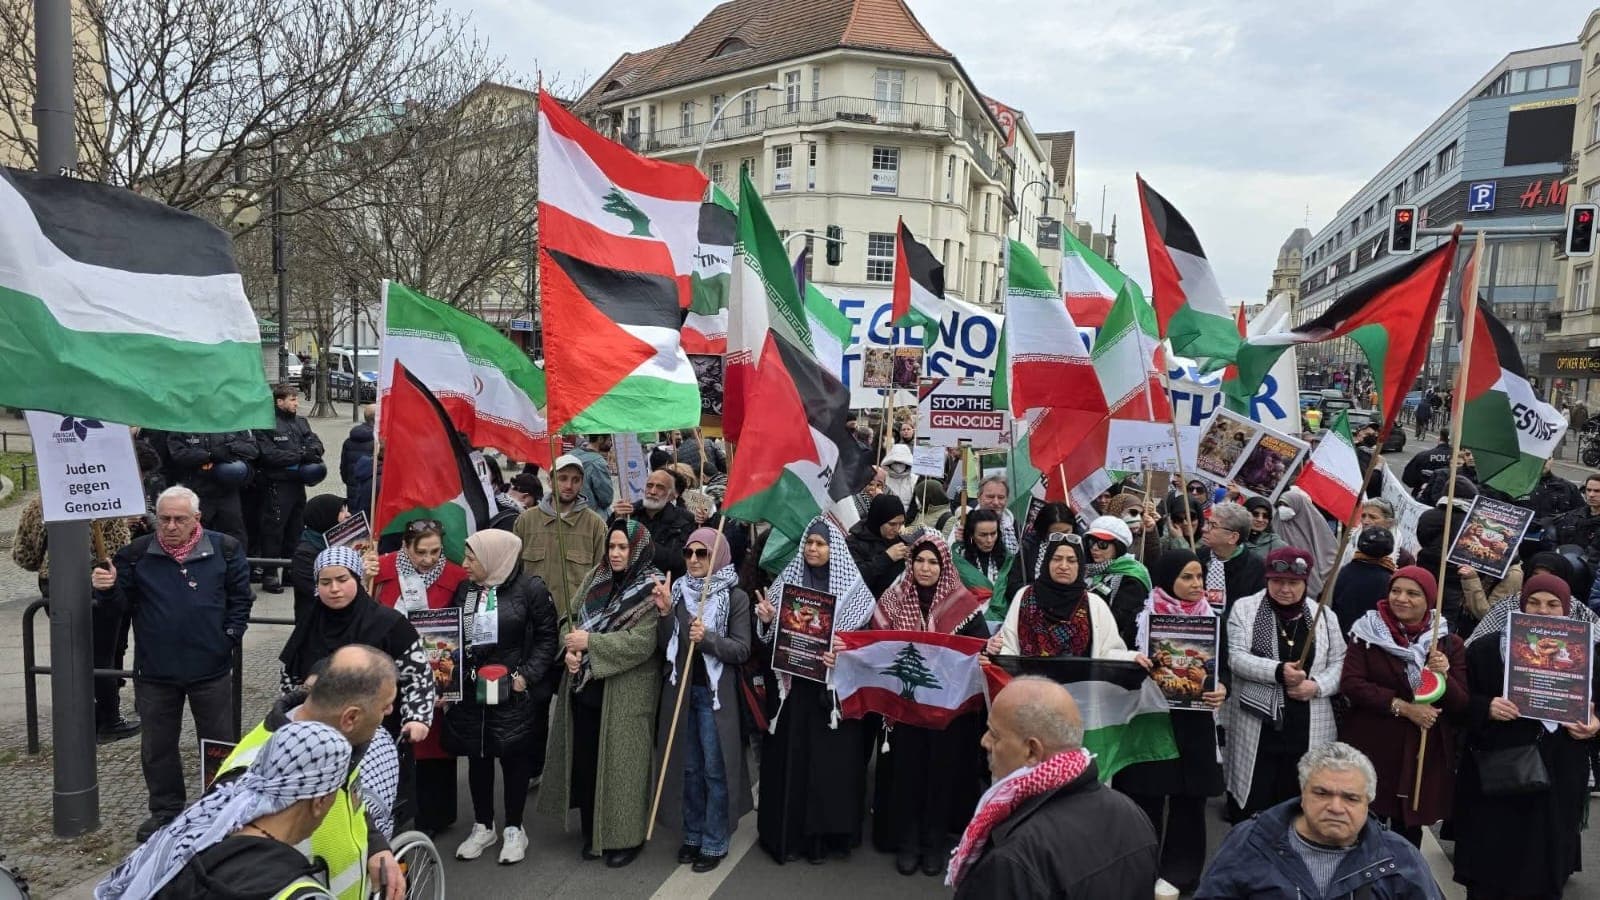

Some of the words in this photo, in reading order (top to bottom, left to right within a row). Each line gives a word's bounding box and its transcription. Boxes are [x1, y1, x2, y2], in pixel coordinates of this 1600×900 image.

[1477, 188, 1490, 203] P
[932, 397, 965, 410] STOP
[966, 398, 991, 410] THE
[932, 415, 1001, 428] GENOCIDE
[66, 463, 106, 475] Juden
[69, 481, 110, 495] gegen
[64, 498, 122, 513] Genozid
